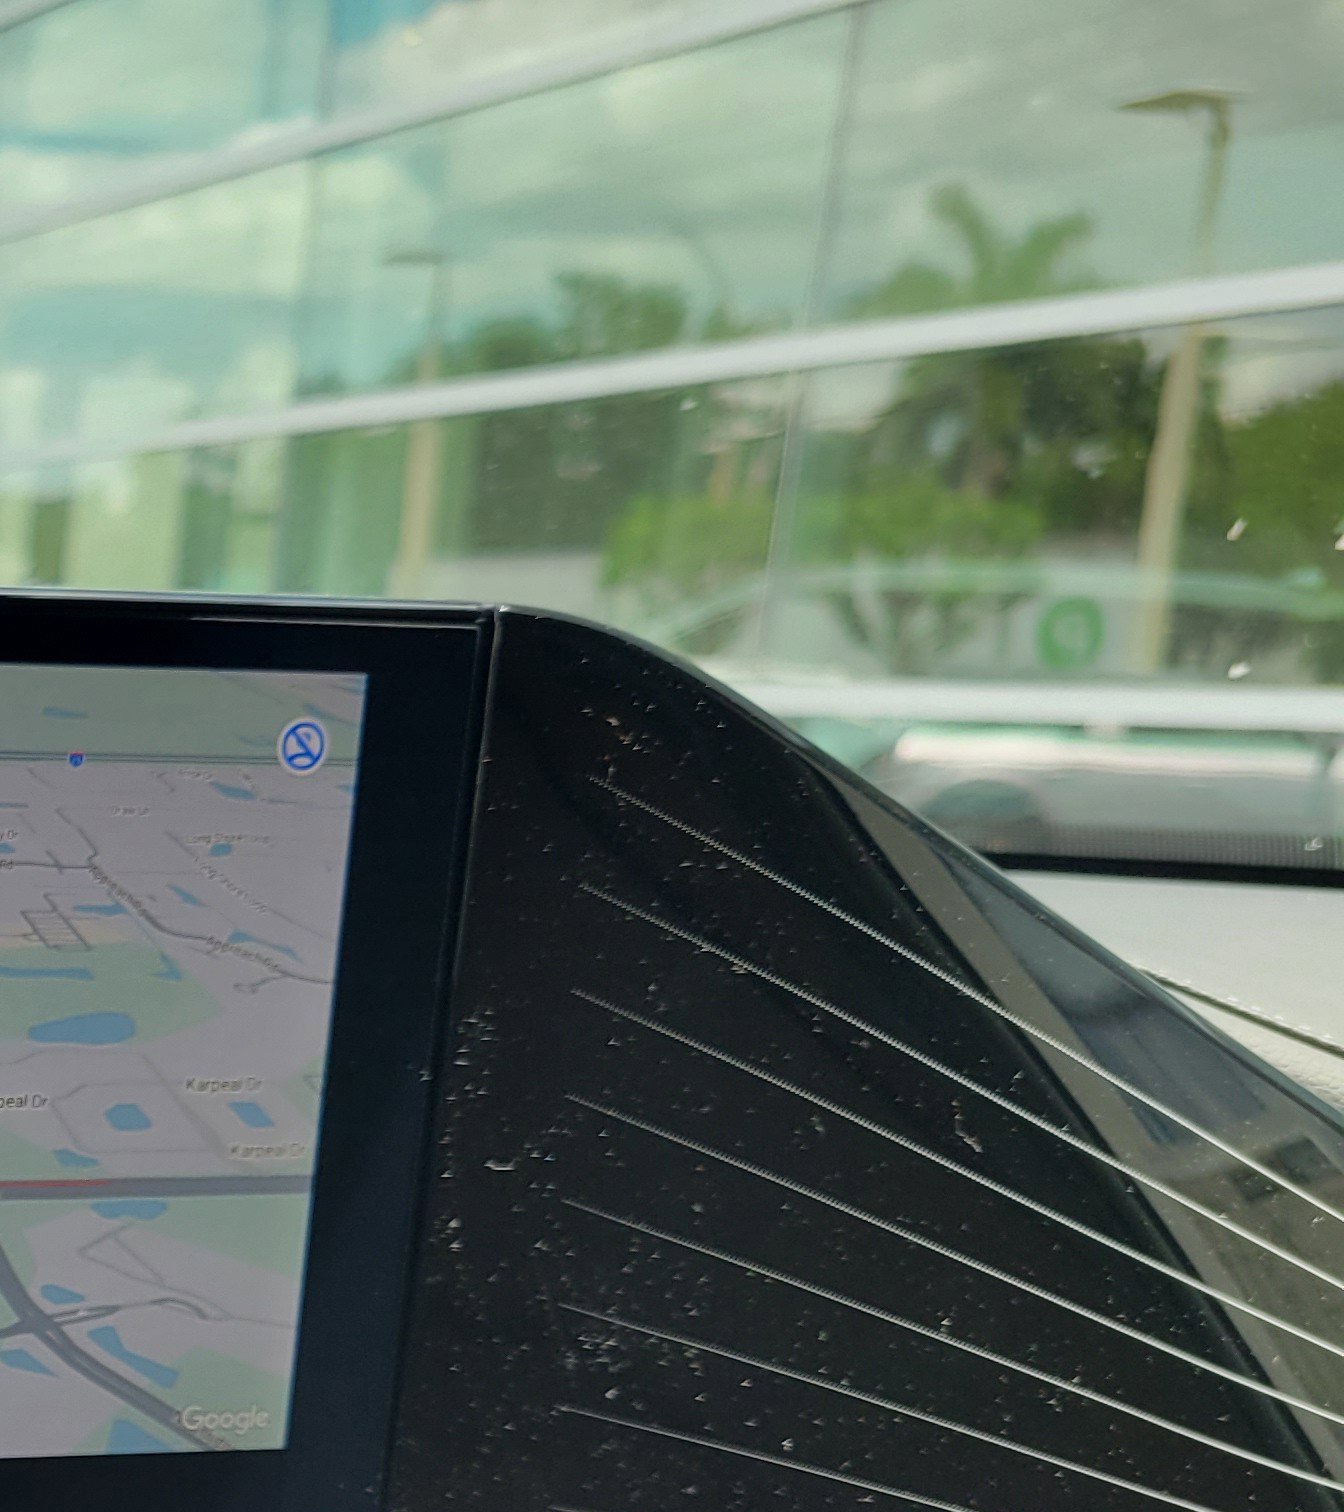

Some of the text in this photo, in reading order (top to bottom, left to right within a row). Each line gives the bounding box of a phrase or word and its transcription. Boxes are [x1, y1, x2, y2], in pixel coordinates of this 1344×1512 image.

[186, 1076, 262, 1094] Karpeal Dr
[31, 1094, 48, 1109] Dr
[230, 1143, 306, 1160] Karpeal Dr
[181, 1404, 270, 1436] Google
